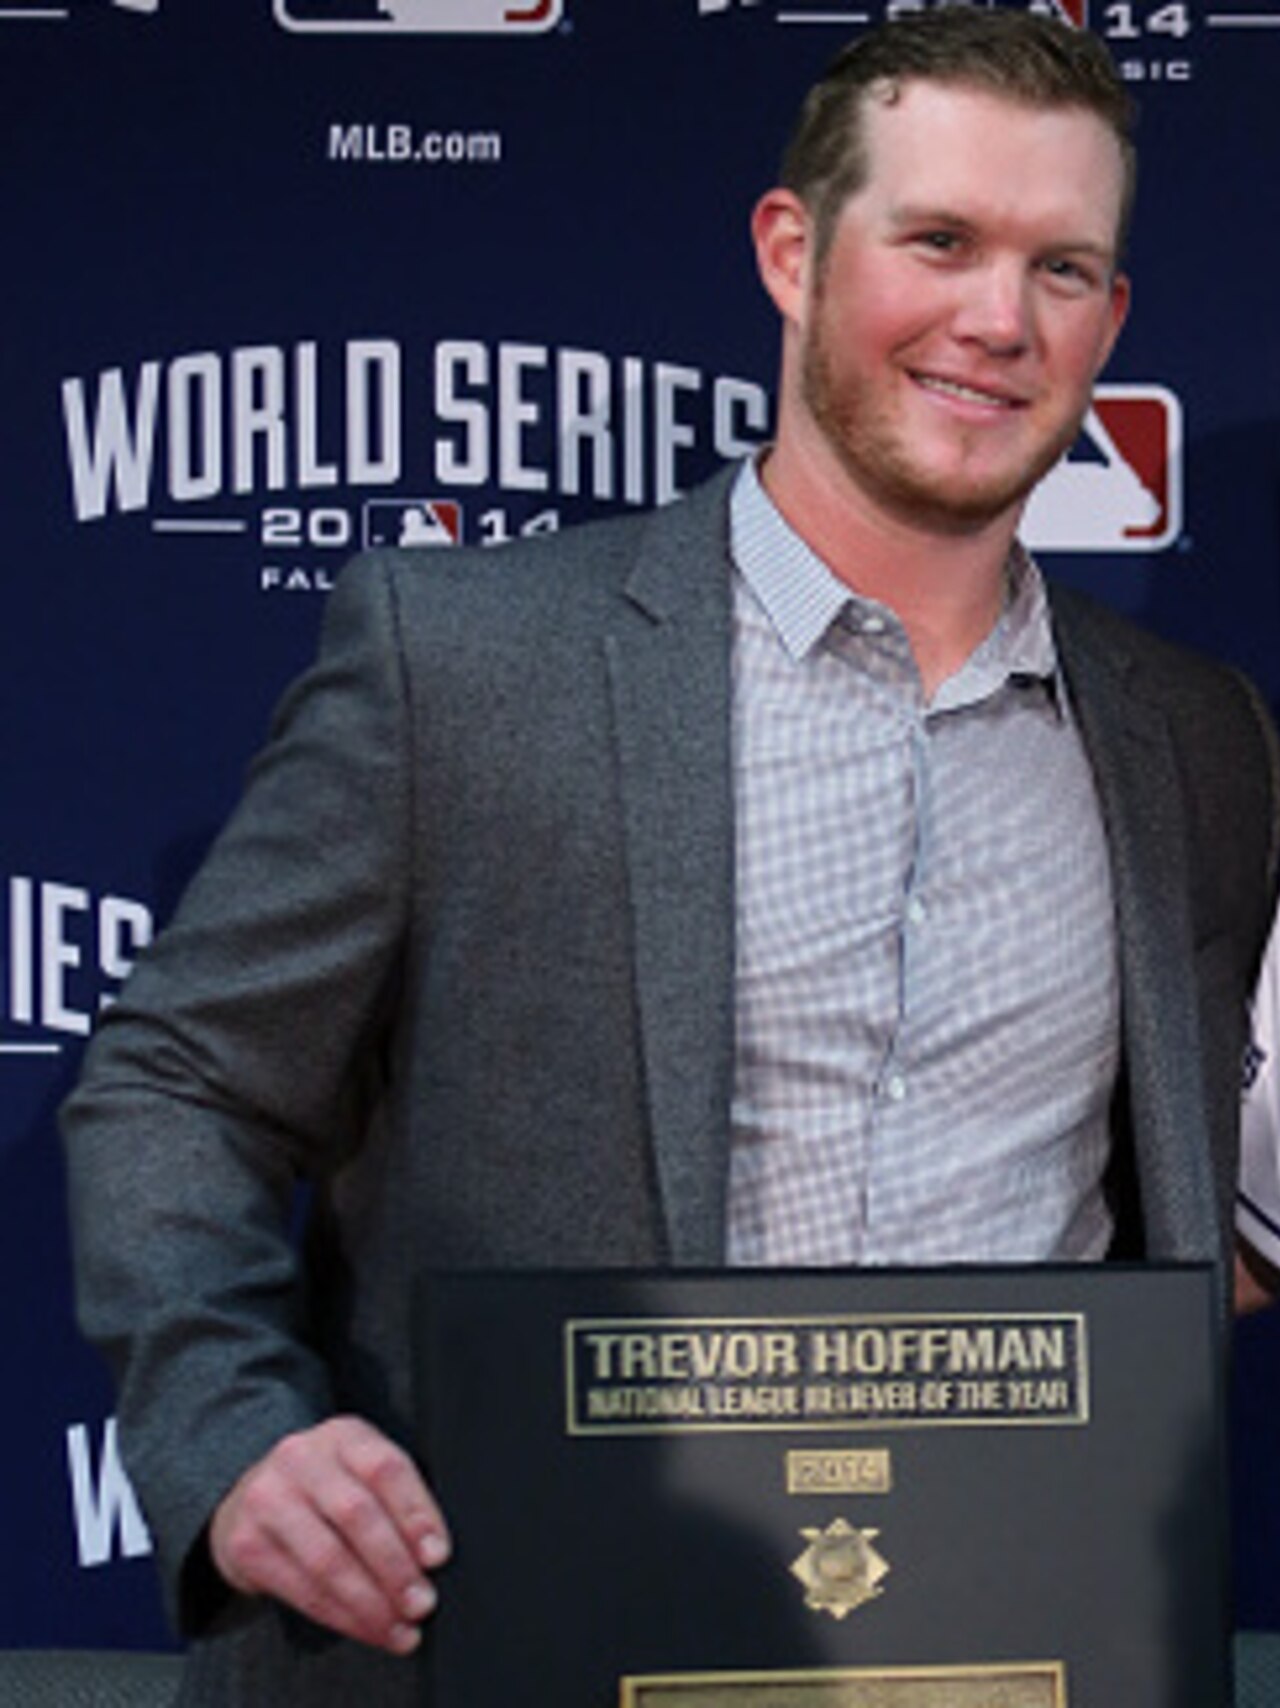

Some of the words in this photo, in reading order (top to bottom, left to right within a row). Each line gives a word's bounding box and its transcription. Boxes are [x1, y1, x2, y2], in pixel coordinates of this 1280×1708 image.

[1104, 3, 1191, 39] 14
[328, 124, 501, 161] MLB.com
[61, 339, 402, 522] WORLD
[434, 339, 769, 505] SERIES
[261, 508, 350, 547] 20
[261, 566, 335, 591] FAL
[585, 1332, 800, 1380] TREVOR
[811, 1328, 1066, 1375] HOFFMAN
[706, 1384, 800, 1416] LEAGUE
[918, 1380, 952, 1411] OF
[955, 1379, 1003, 1410] THE
[1006, 1377, 1069, 1410] YEAR
[798, 1457, 880, 1486] 2014
